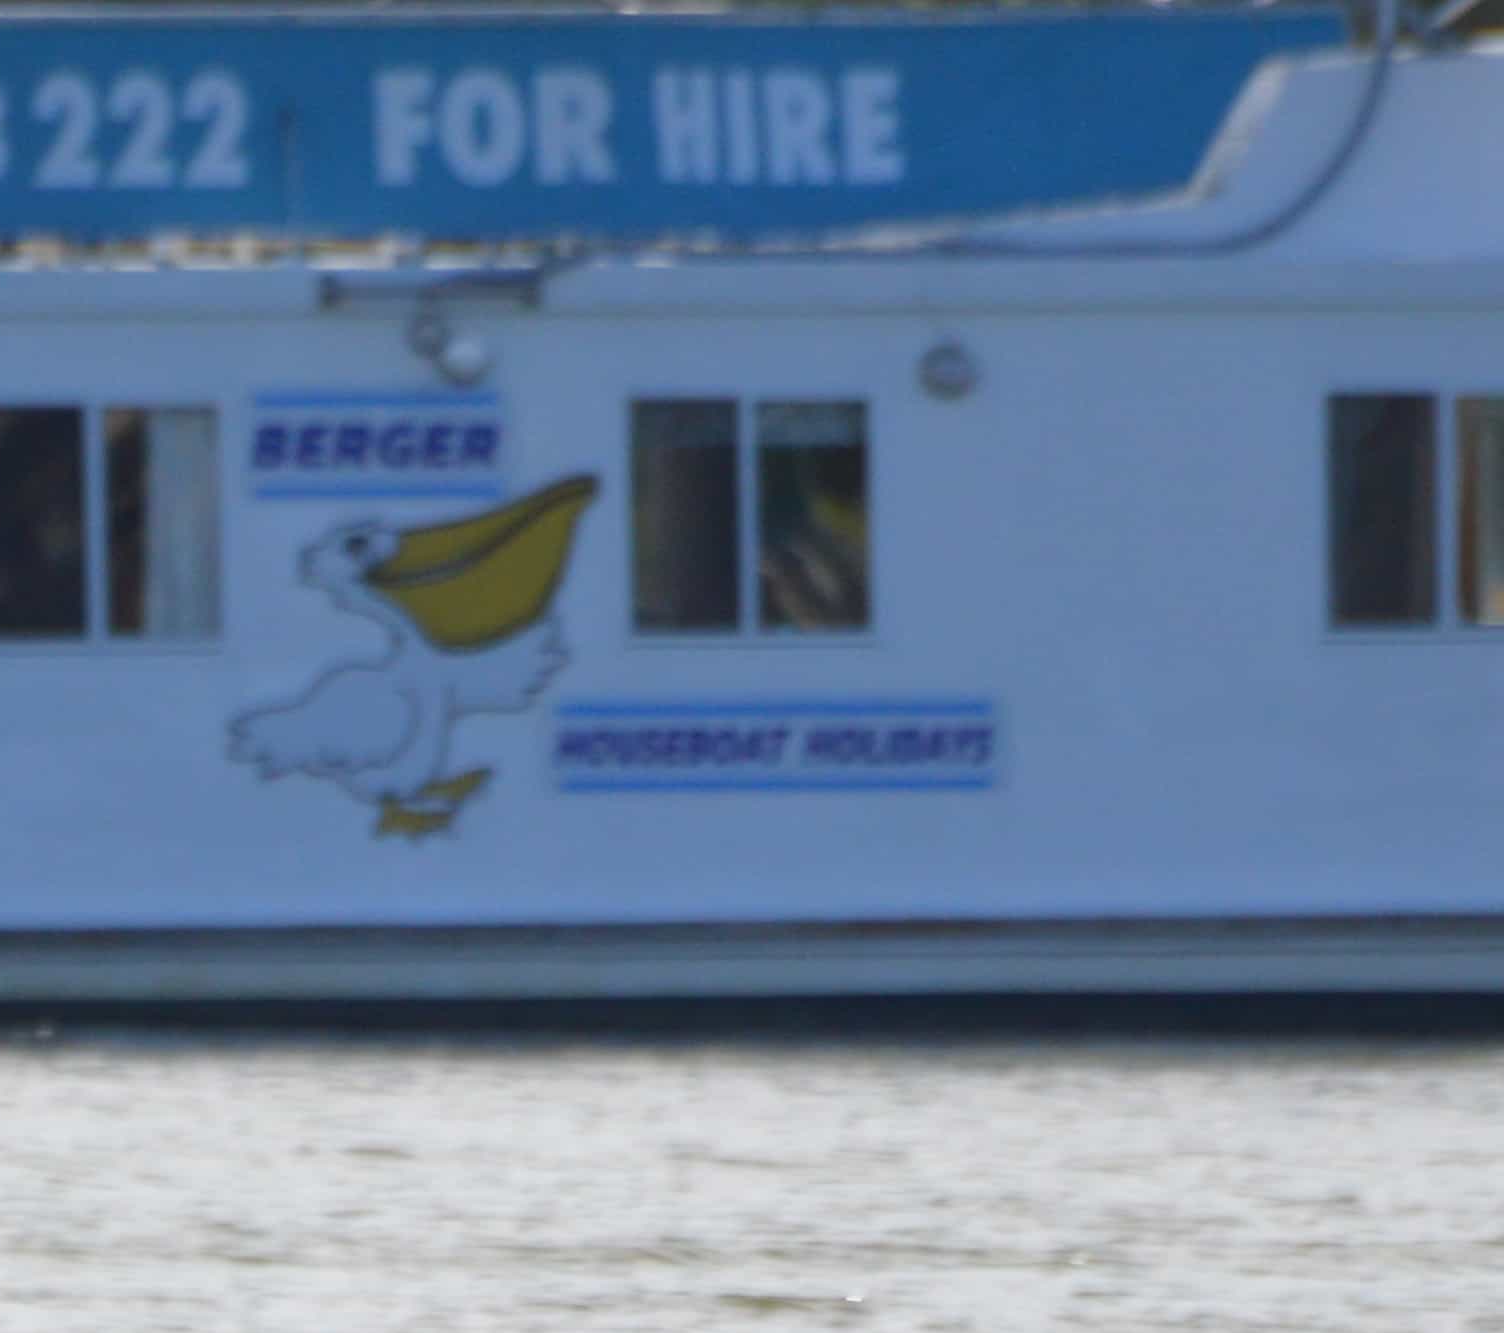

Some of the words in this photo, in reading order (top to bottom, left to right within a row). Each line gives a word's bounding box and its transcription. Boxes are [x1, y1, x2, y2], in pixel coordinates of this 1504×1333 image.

[30, 71, 249, 192] 222
[371, 67, 616, 188] FOR
[650, 67, 908, 186] HIRE
[250, 422, 502, 470] BERGER
[554, 725, 790, 768] HOUSEBOAT
[805, 724, 995, 767] HOLIDAYS
